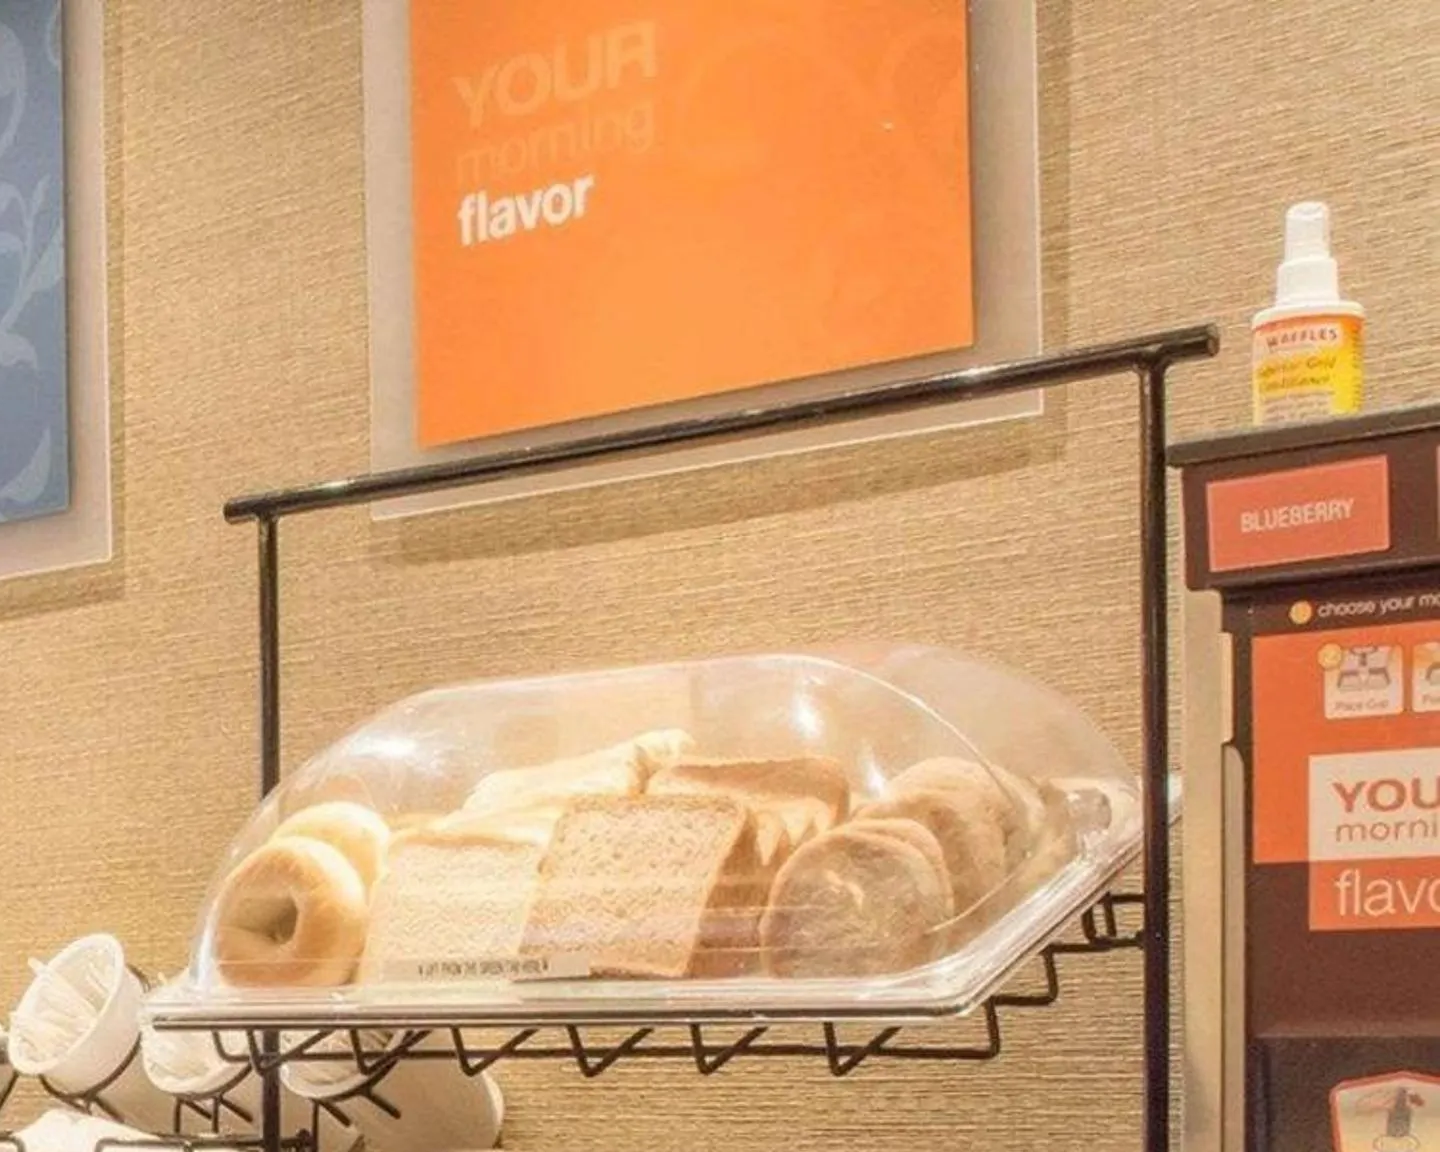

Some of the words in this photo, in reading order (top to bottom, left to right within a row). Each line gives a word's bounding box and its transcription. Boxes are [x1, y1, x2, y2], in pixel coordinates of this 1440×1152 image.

[453, 20, 658, 128] YOUR
[455, 98, 656, 184] morning
[457, 174, 594, 246] flavor
[1266, 328, 1338, 348] WAFFLES
[1240, 498, 1354, 533] BLUEBERRY
[1317, 600, 1375, 618] choose
[1380, 596, 1416, 616] your
